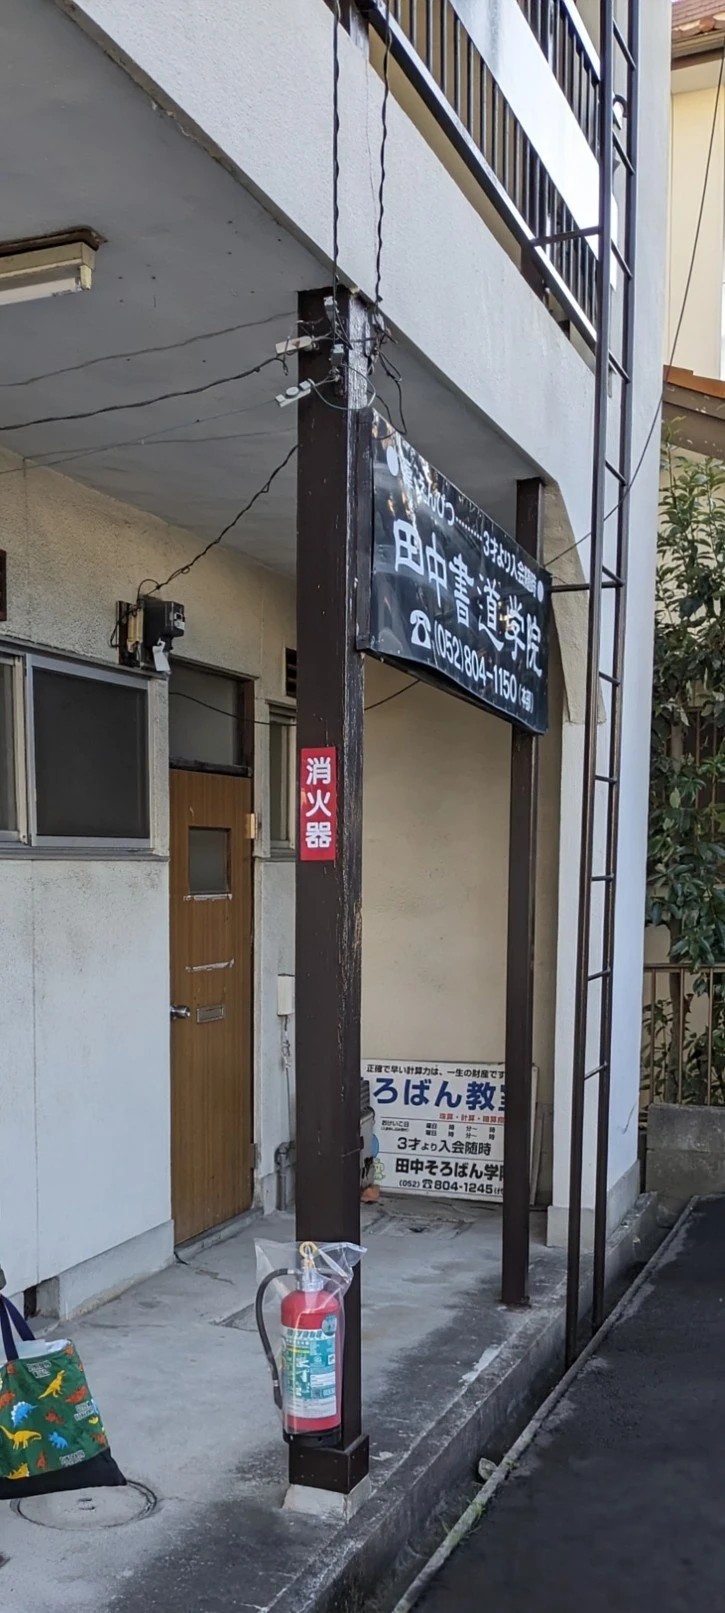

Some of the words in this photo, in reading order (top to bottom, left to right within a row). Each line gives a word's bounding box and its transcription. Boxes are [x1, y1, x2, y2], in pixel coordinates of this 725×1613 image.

[393, 518, 543, 677] 田中書道学院
[305, 756, 332, 849] 消火器
[397, 1137, 491, 1156] 3才より入会随時
[399, 1179, 420, 1188] (052)
